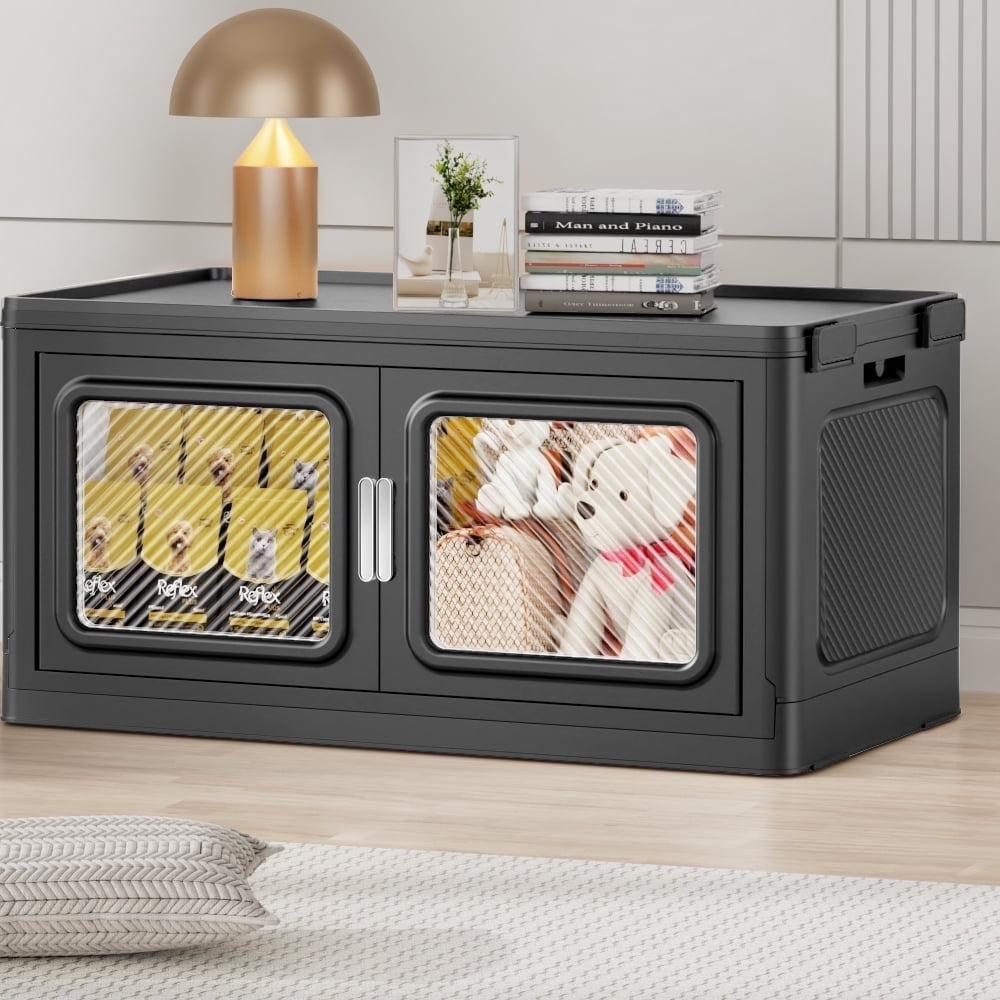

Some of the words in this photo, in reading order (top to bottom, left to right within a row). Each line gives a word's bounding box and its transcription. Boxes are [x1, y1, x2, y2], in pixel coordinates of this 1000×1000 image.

[554, 220, 593, 230] Man
[598, 220, 630, 231] and
[634, 221, 683, 231] Piano
[157, 577, 198, 600] Reflex
[239, 584, 281, 606] Reflex
